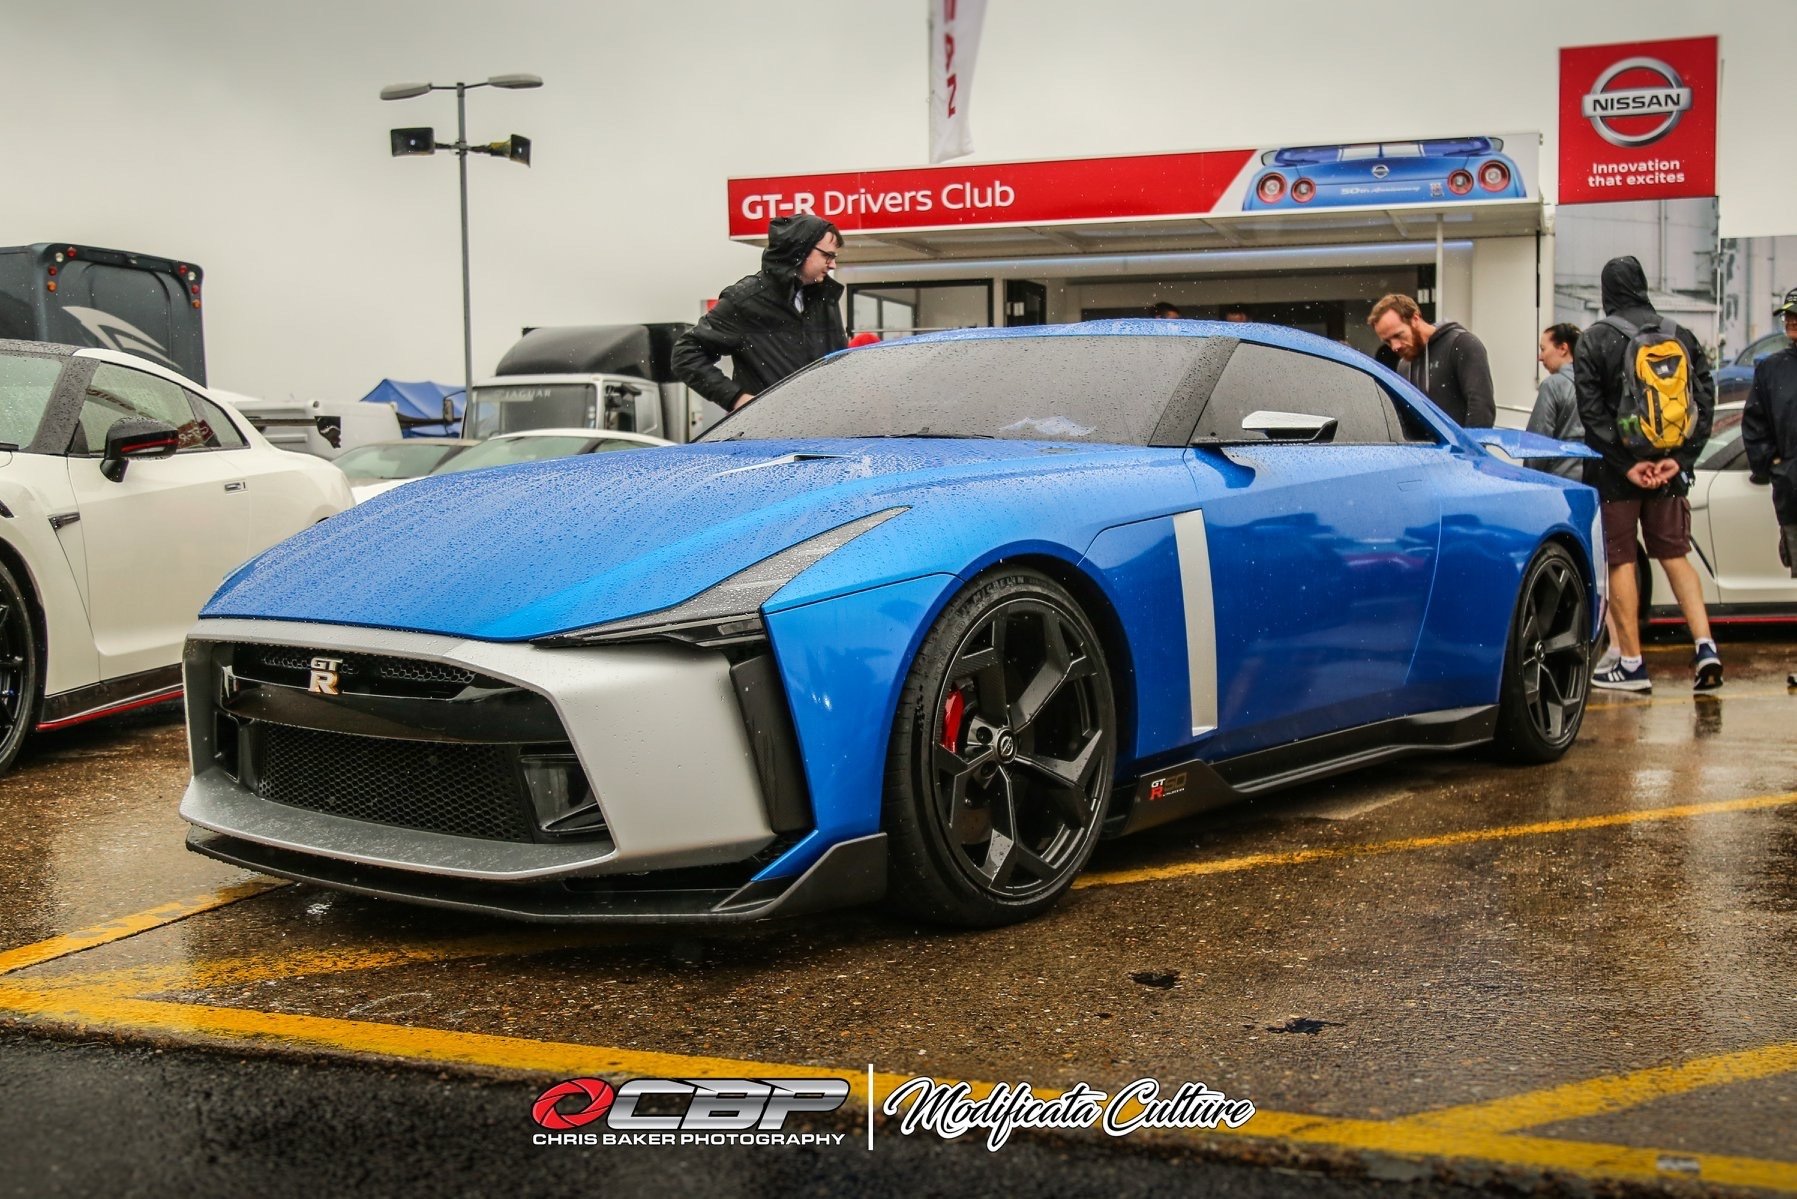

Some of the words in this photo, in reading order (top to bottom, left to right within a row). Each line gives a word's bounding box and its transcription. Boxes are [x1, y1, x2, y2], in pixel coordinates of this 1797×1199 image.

[1592, 93, 1680, 112] NISSAN
[1592, 158, 1680, 175] Innovation
[1588, 174, 1622, 187] that
[1626, 172, 1685, 186] excites
[741, 192, 815, 220] GT-R
[823, 187, 933, 217] Drivers
[941, 180, 1015, 210] Club
[973, 575, 1025, 601] MICHELIN
